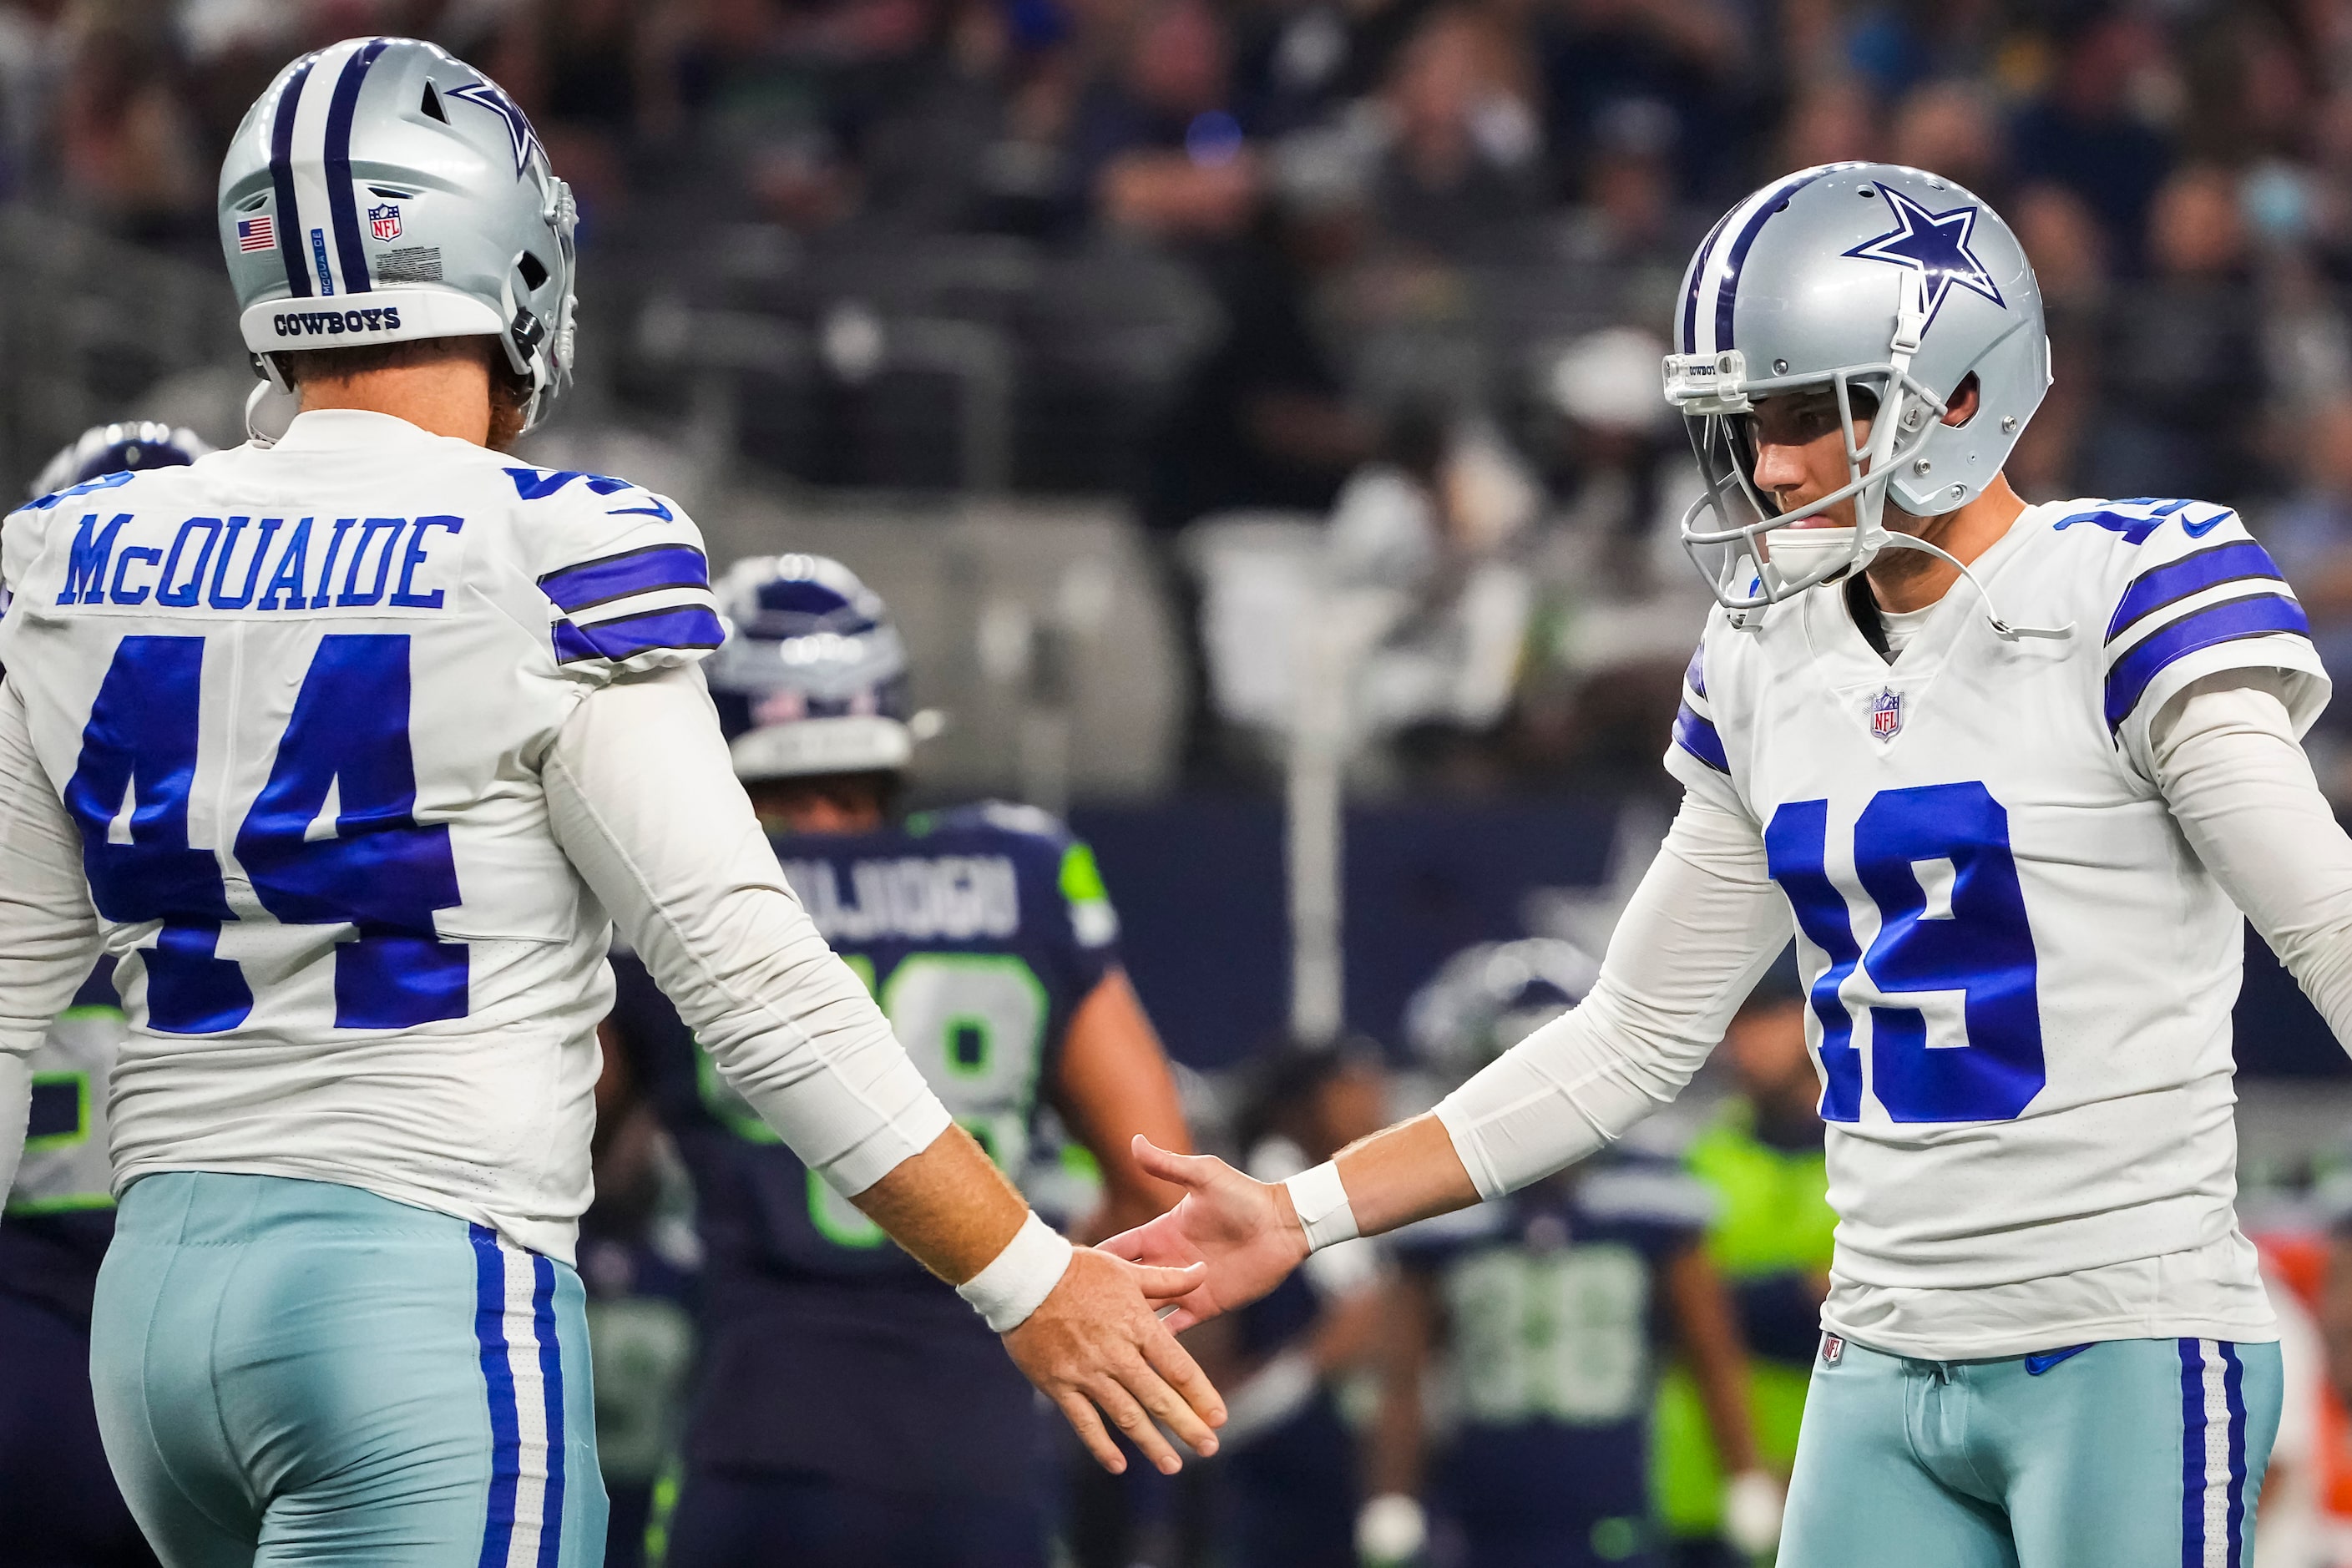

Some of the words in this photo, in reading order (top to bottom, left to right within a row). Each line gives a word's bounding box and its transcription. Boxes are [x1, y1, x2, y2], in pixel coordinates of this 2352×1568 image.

[372, 219, 400, 238] NFL
[274, 306, 401, 336] COWBOYS
[55, 513, 465, 611] McQUAIDE
[1874, 711, 1897, 732] NFL
[64, 632, 471, 1035] 44
[1764, 781, 2046, 1123] 19
